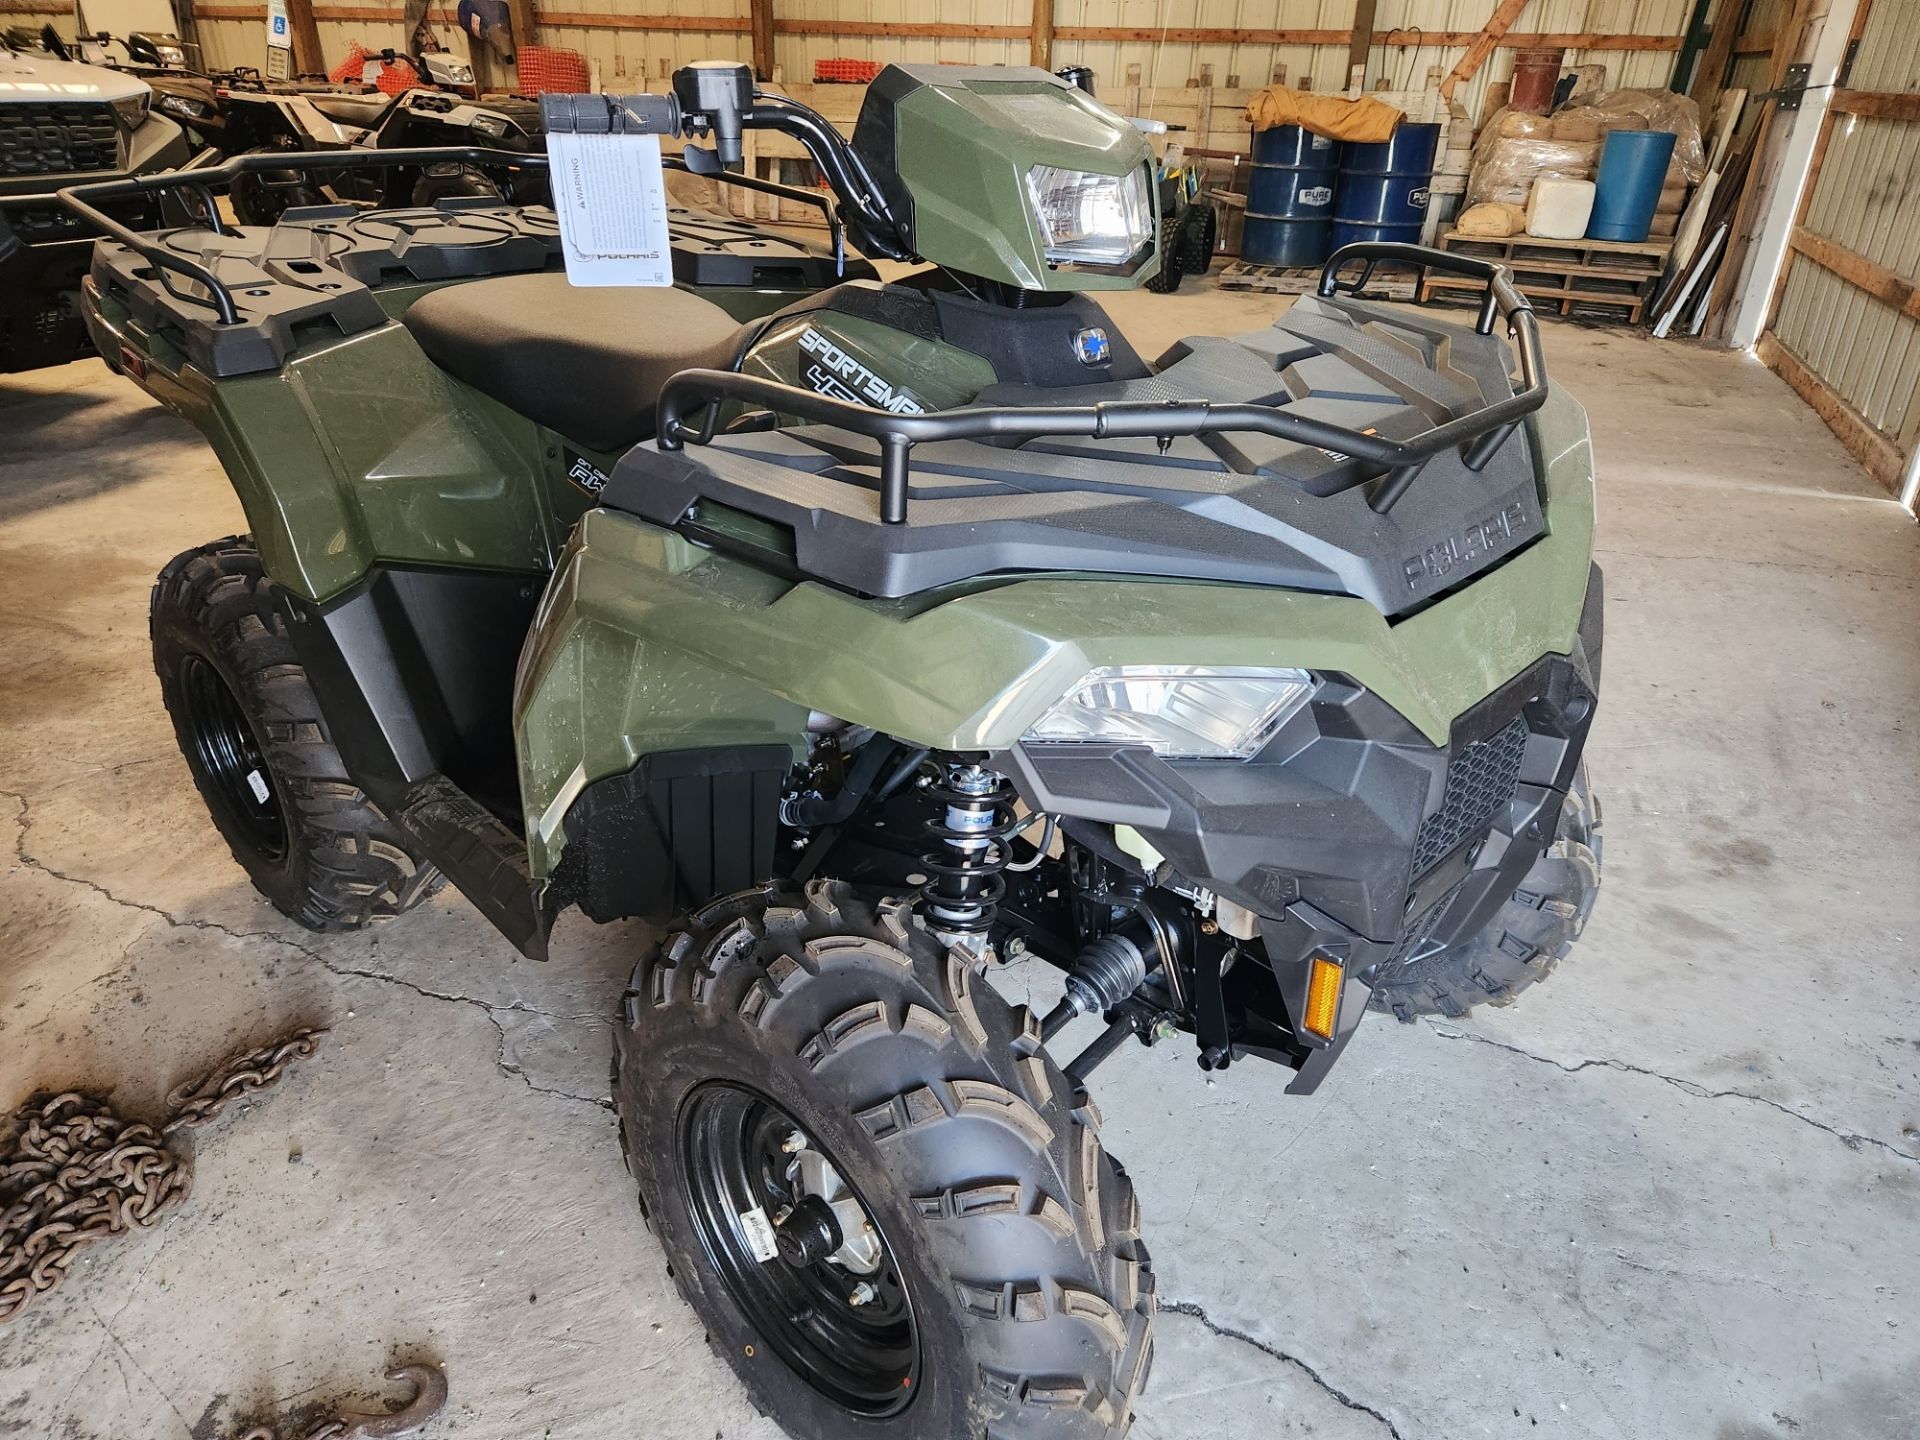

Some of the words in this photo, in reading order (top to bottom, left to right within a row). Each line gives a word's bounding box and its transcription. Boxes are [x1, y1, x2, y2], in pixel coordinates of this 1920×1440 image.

[571, 157, 584, 201] WARNING
[1305, 190, 1330, 199] PURE
[797, 327, 925, 414] SPORTSMA
[569, 464, 606, 491] AW
[1402, 501, 1527, 590] POLARIS
